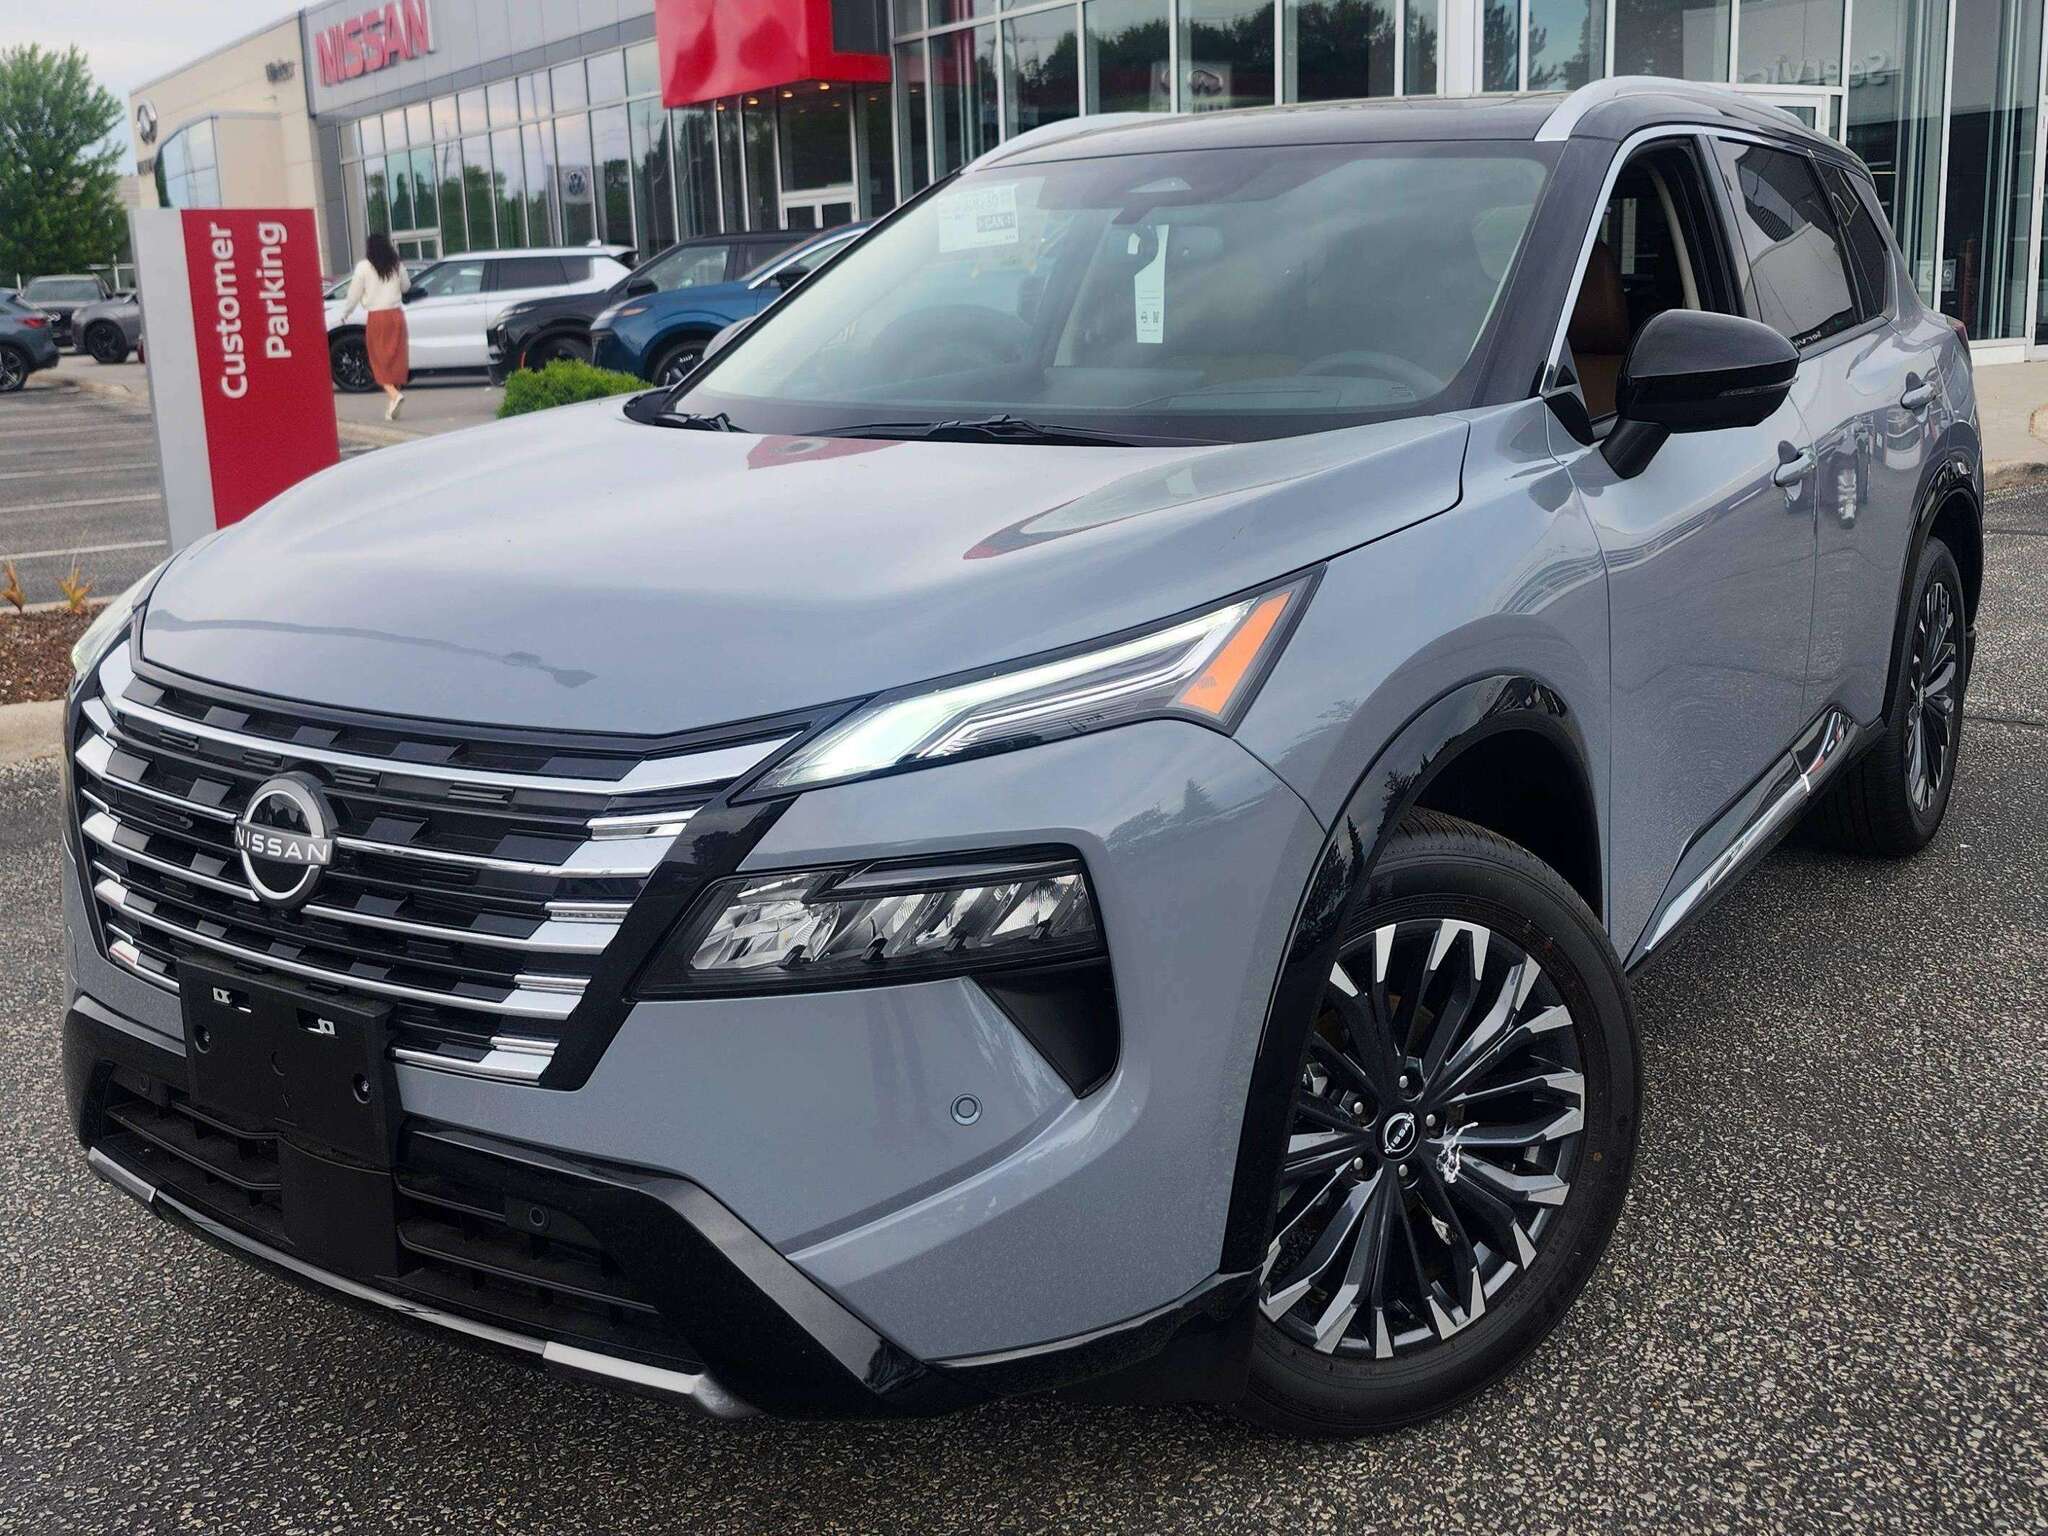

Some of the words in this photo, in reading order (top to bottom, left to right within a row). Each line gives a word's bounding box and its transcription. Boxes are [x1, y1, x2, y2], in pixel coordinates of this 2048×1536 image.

[315, 0, 430, 87] NISSAN
[209, 221, 249, 399] Customer
[256, 221, 292, 359] Parking
[234, 825, 328, 862] NISSAN
